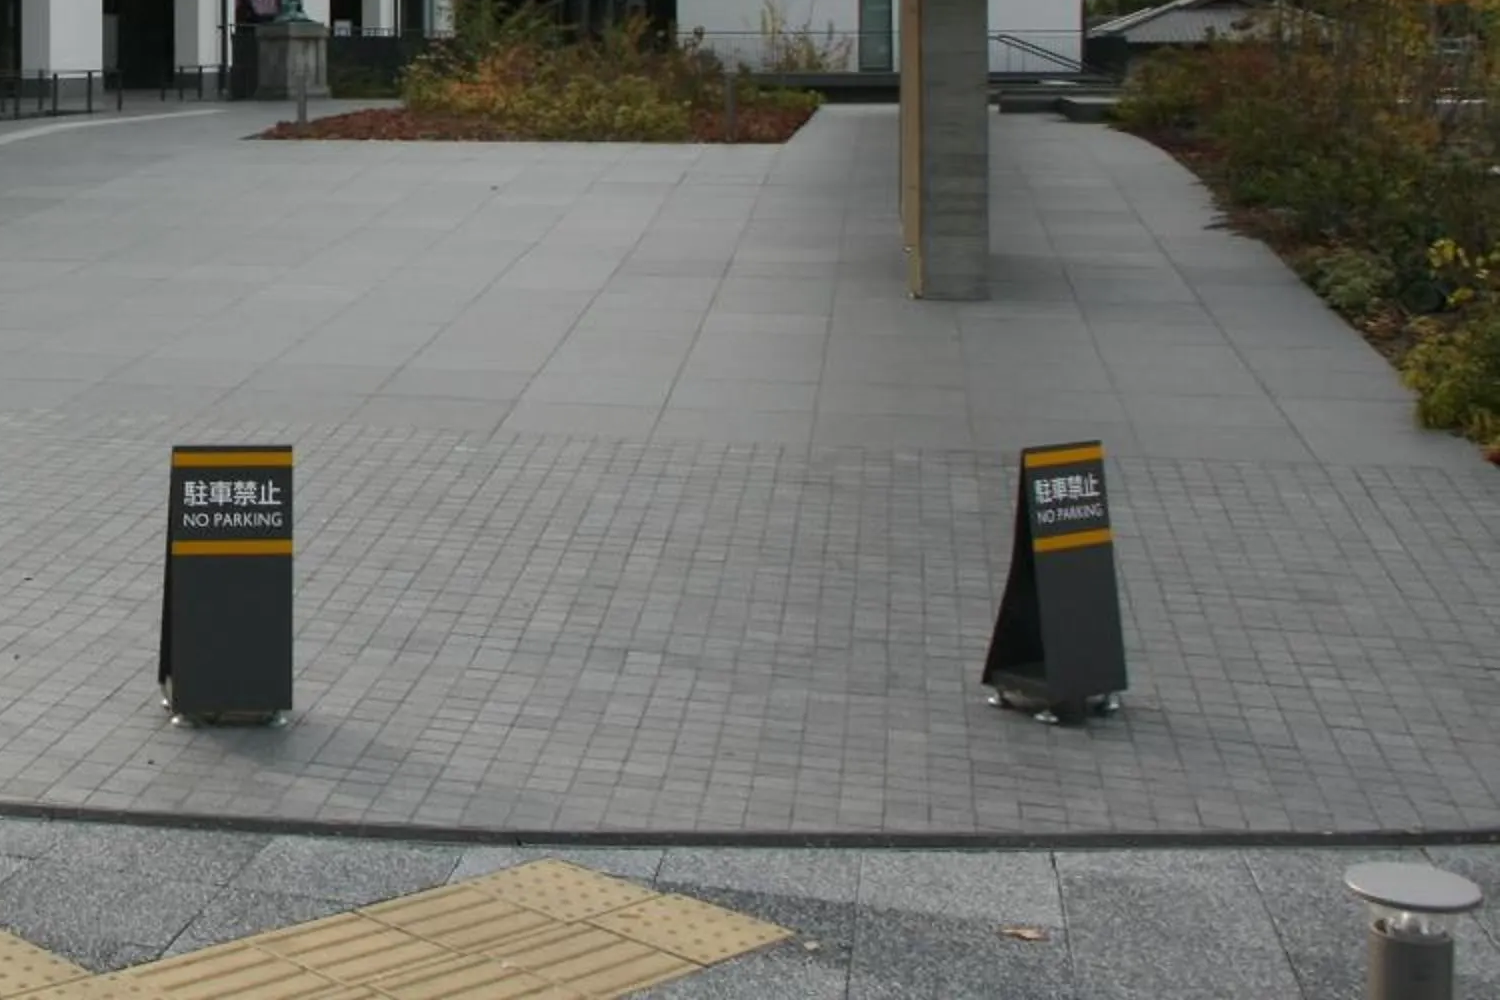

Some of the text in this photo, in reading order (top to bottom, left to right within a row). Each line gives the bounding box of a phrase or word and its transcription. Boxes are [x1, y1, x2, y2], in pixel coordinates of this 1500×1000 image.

[183, 480, 282, 506] 駐車禁止
[183, 512, 283, 527] NO PARKING
[1037, 509, 1056, 524] NO
